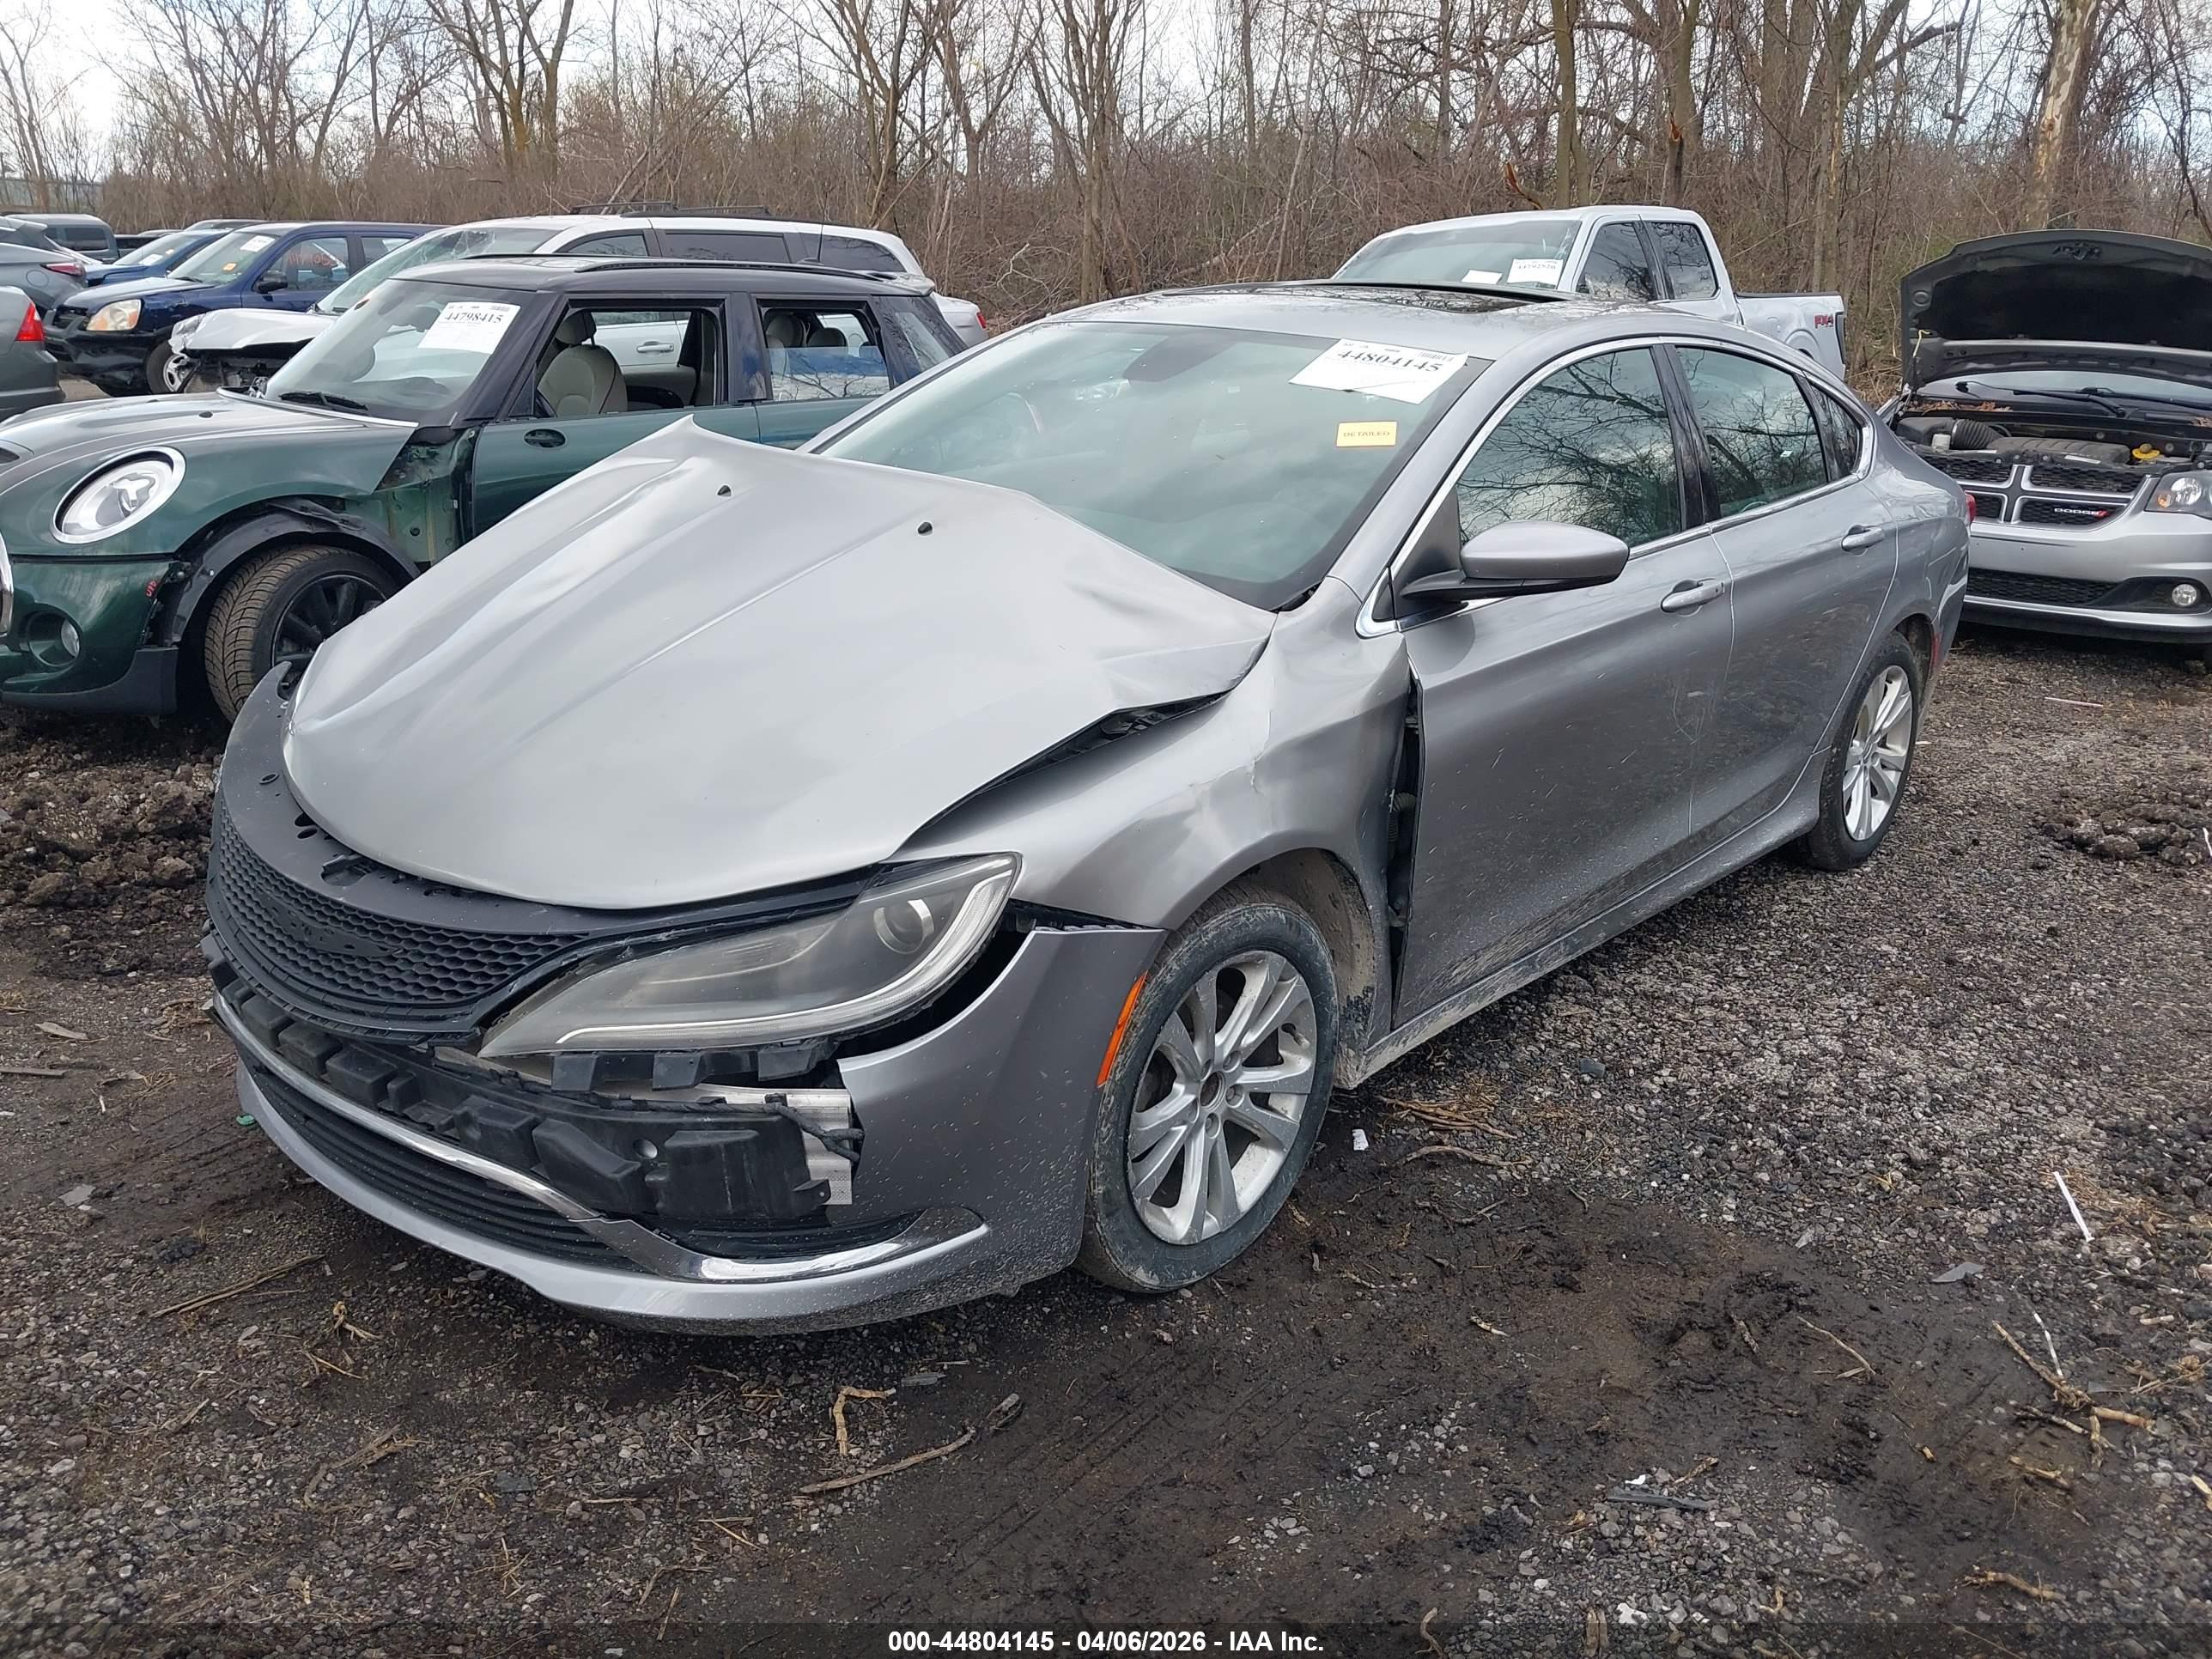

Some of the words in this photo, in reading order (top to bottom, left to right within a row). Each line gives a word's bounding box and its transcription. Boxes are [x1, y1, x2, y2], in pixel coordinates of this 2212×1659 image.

[1814, 314, 1833, 329] FX4
[1337, 350, 1443, 372] 44804145
[2054, 507, 2099, 516] DODGE
